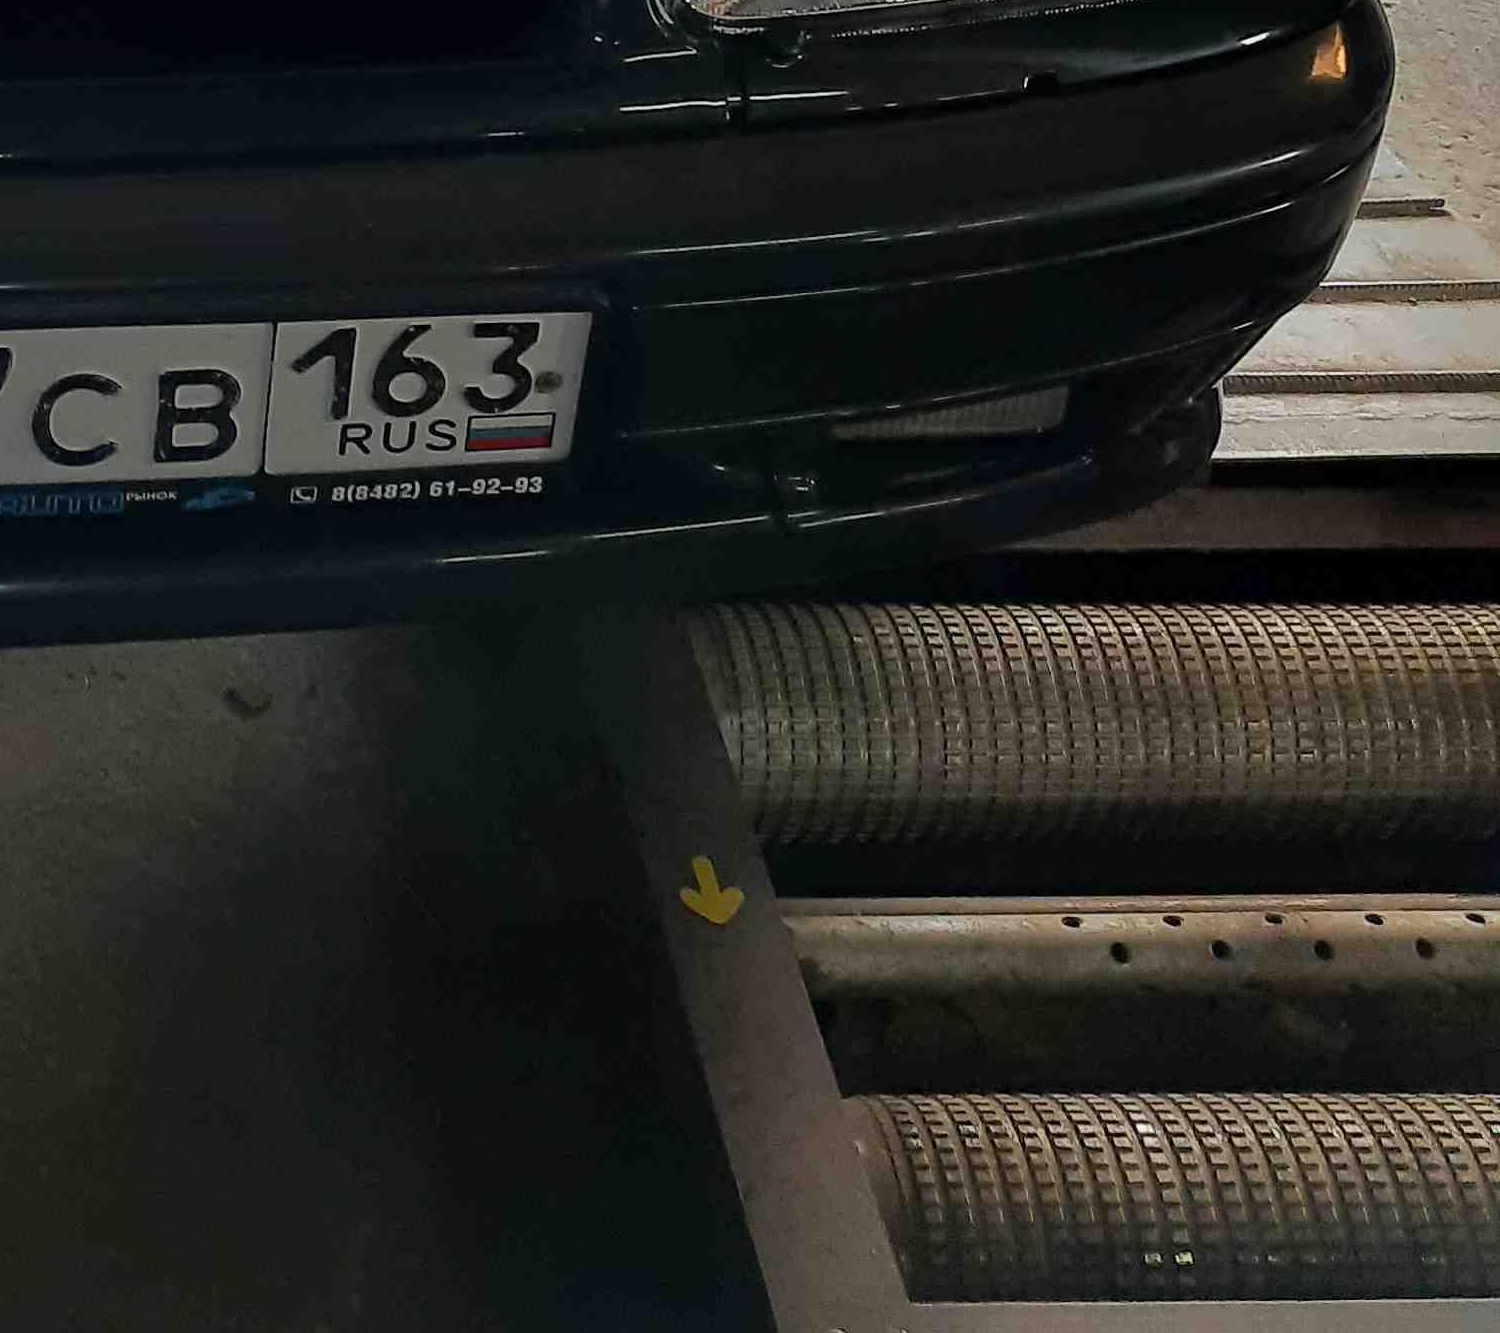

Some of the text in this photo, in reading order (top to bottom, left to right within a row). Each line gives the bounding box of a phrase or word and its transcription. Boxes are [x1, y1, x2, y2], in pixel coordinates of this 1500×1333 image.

[290, 321, 541, 420] 163
[337, 419, 458, 456] RUS
[126, 489, 178, 502] РЫНОК
[331, 476, 543, 502] 8(8482) 61-92-93
